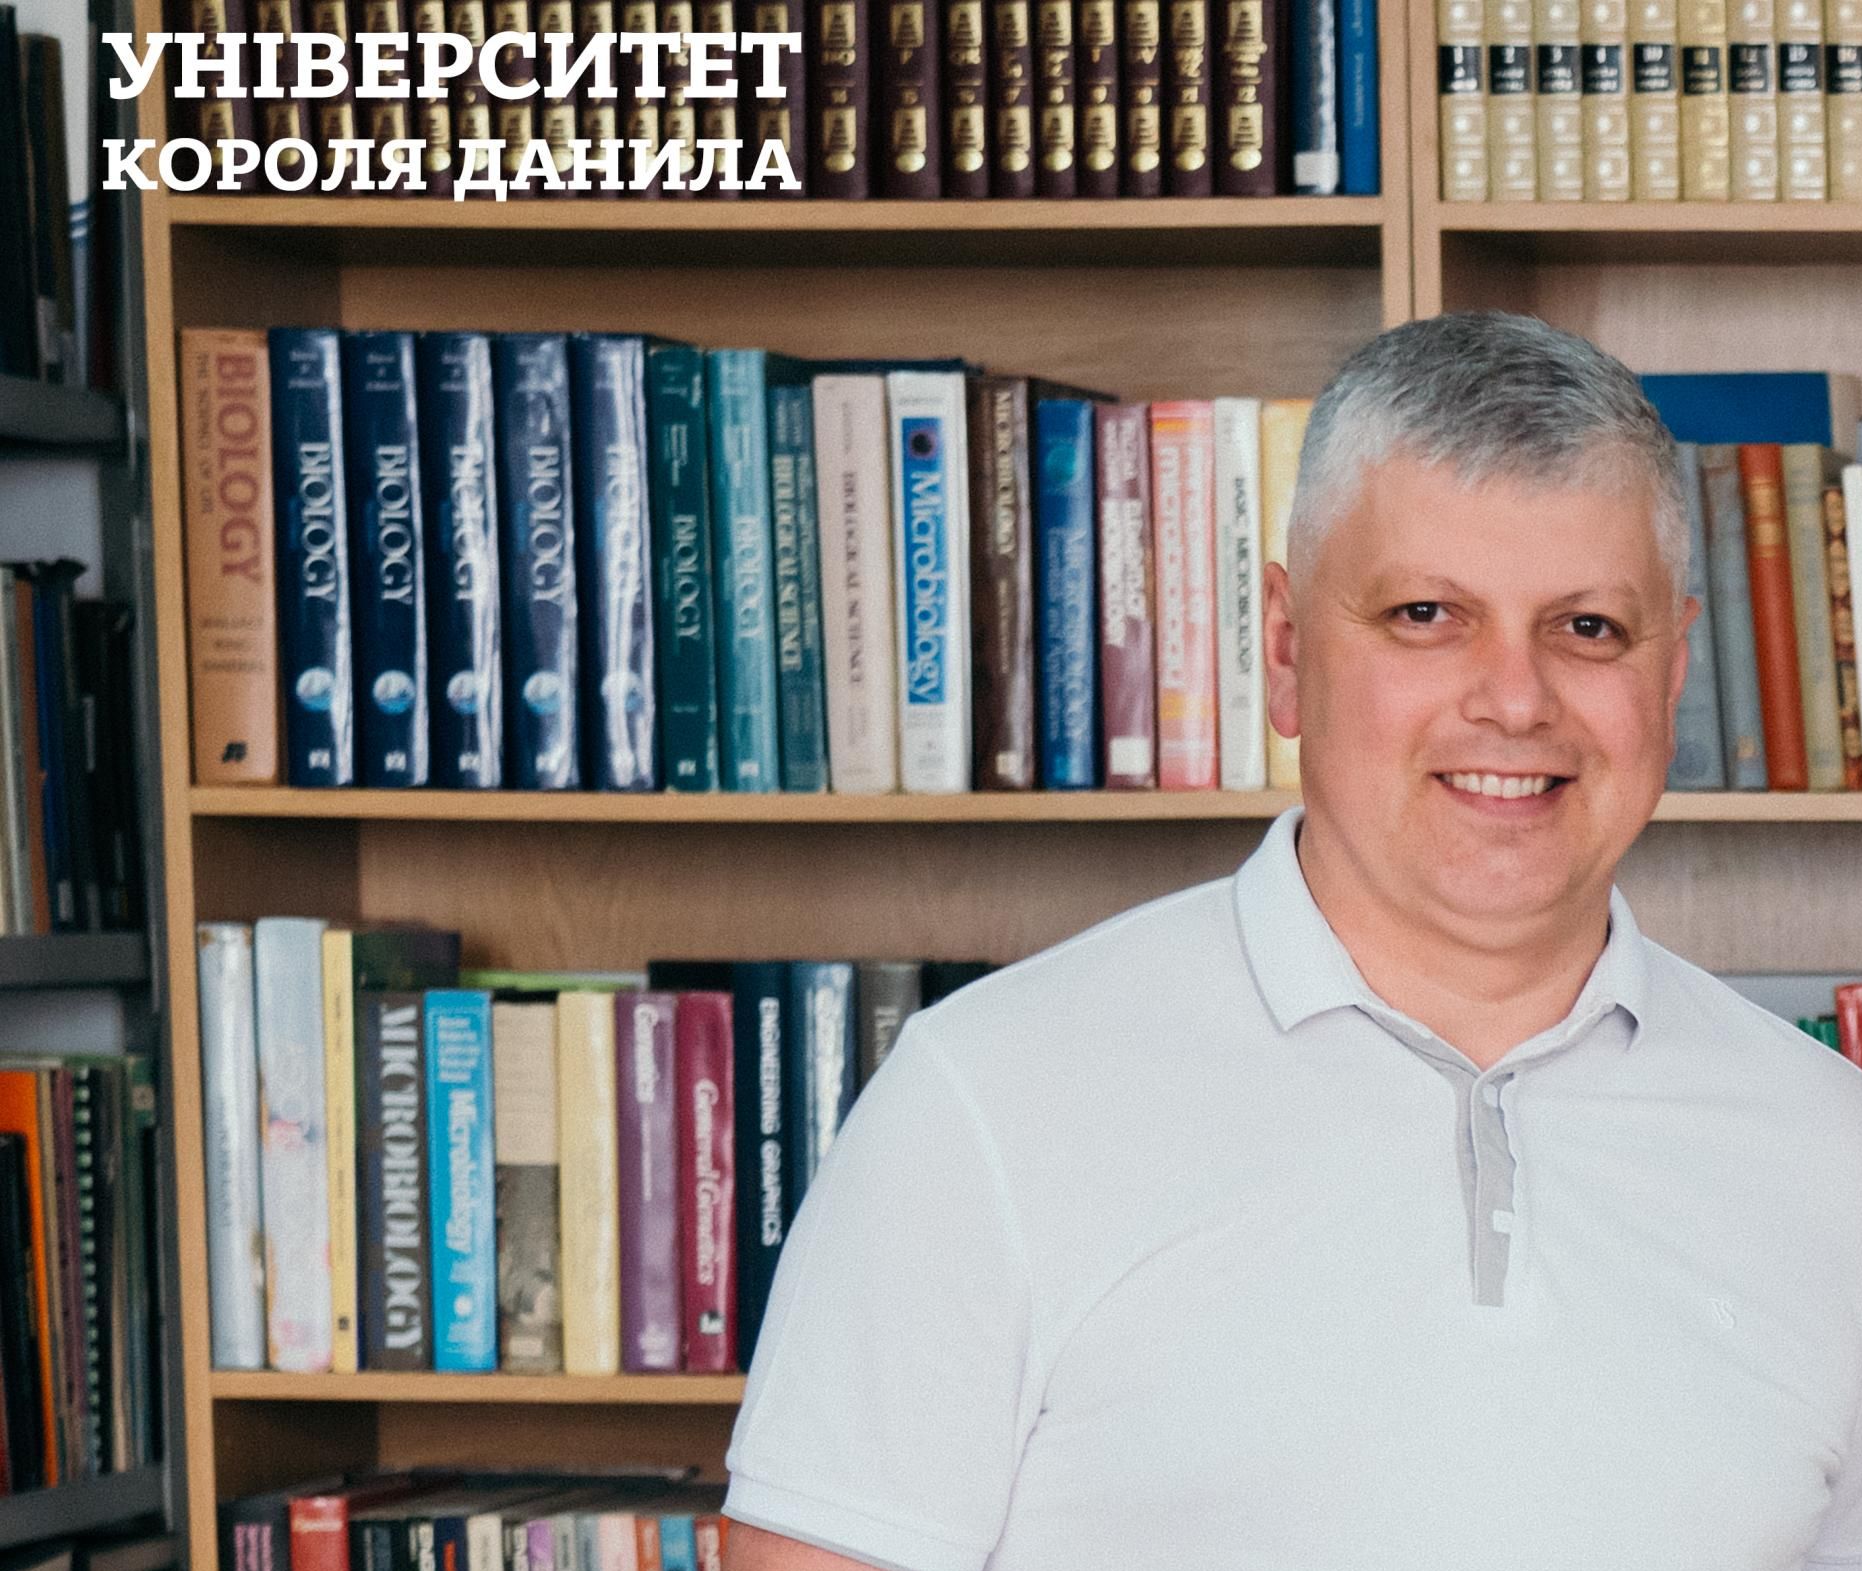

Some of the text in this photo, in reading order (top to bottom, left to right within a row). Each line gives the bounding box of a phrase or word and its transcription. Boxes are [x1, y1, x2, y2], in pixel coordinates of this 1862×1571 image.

[216, 352, 260, 584] BIOLOGY
[299, 442, 337, 602] BIOLOGY
[376, 446, 413, 605] BIOLOGY
[529, 446, 564, 605] BIOLOGY
[995, 391, 1016, 557] MICROBIOLOGY
[673, 514, 700, 641] BIOLOGY
[734, 515, 763, 639] BIOLOGY
[909, 471, 944, 703] Microbiology
[1064, 527, 1088, 742] MICROBIOLOGY
[380, 1004, 422, 1349] MICROBIOLOGY
[447, 1090, 478, 1253] Microbiology
[694, 1079, 720, 1178] General
[759, 997, 782, 1247] ENGINEERING GRAPHICS
